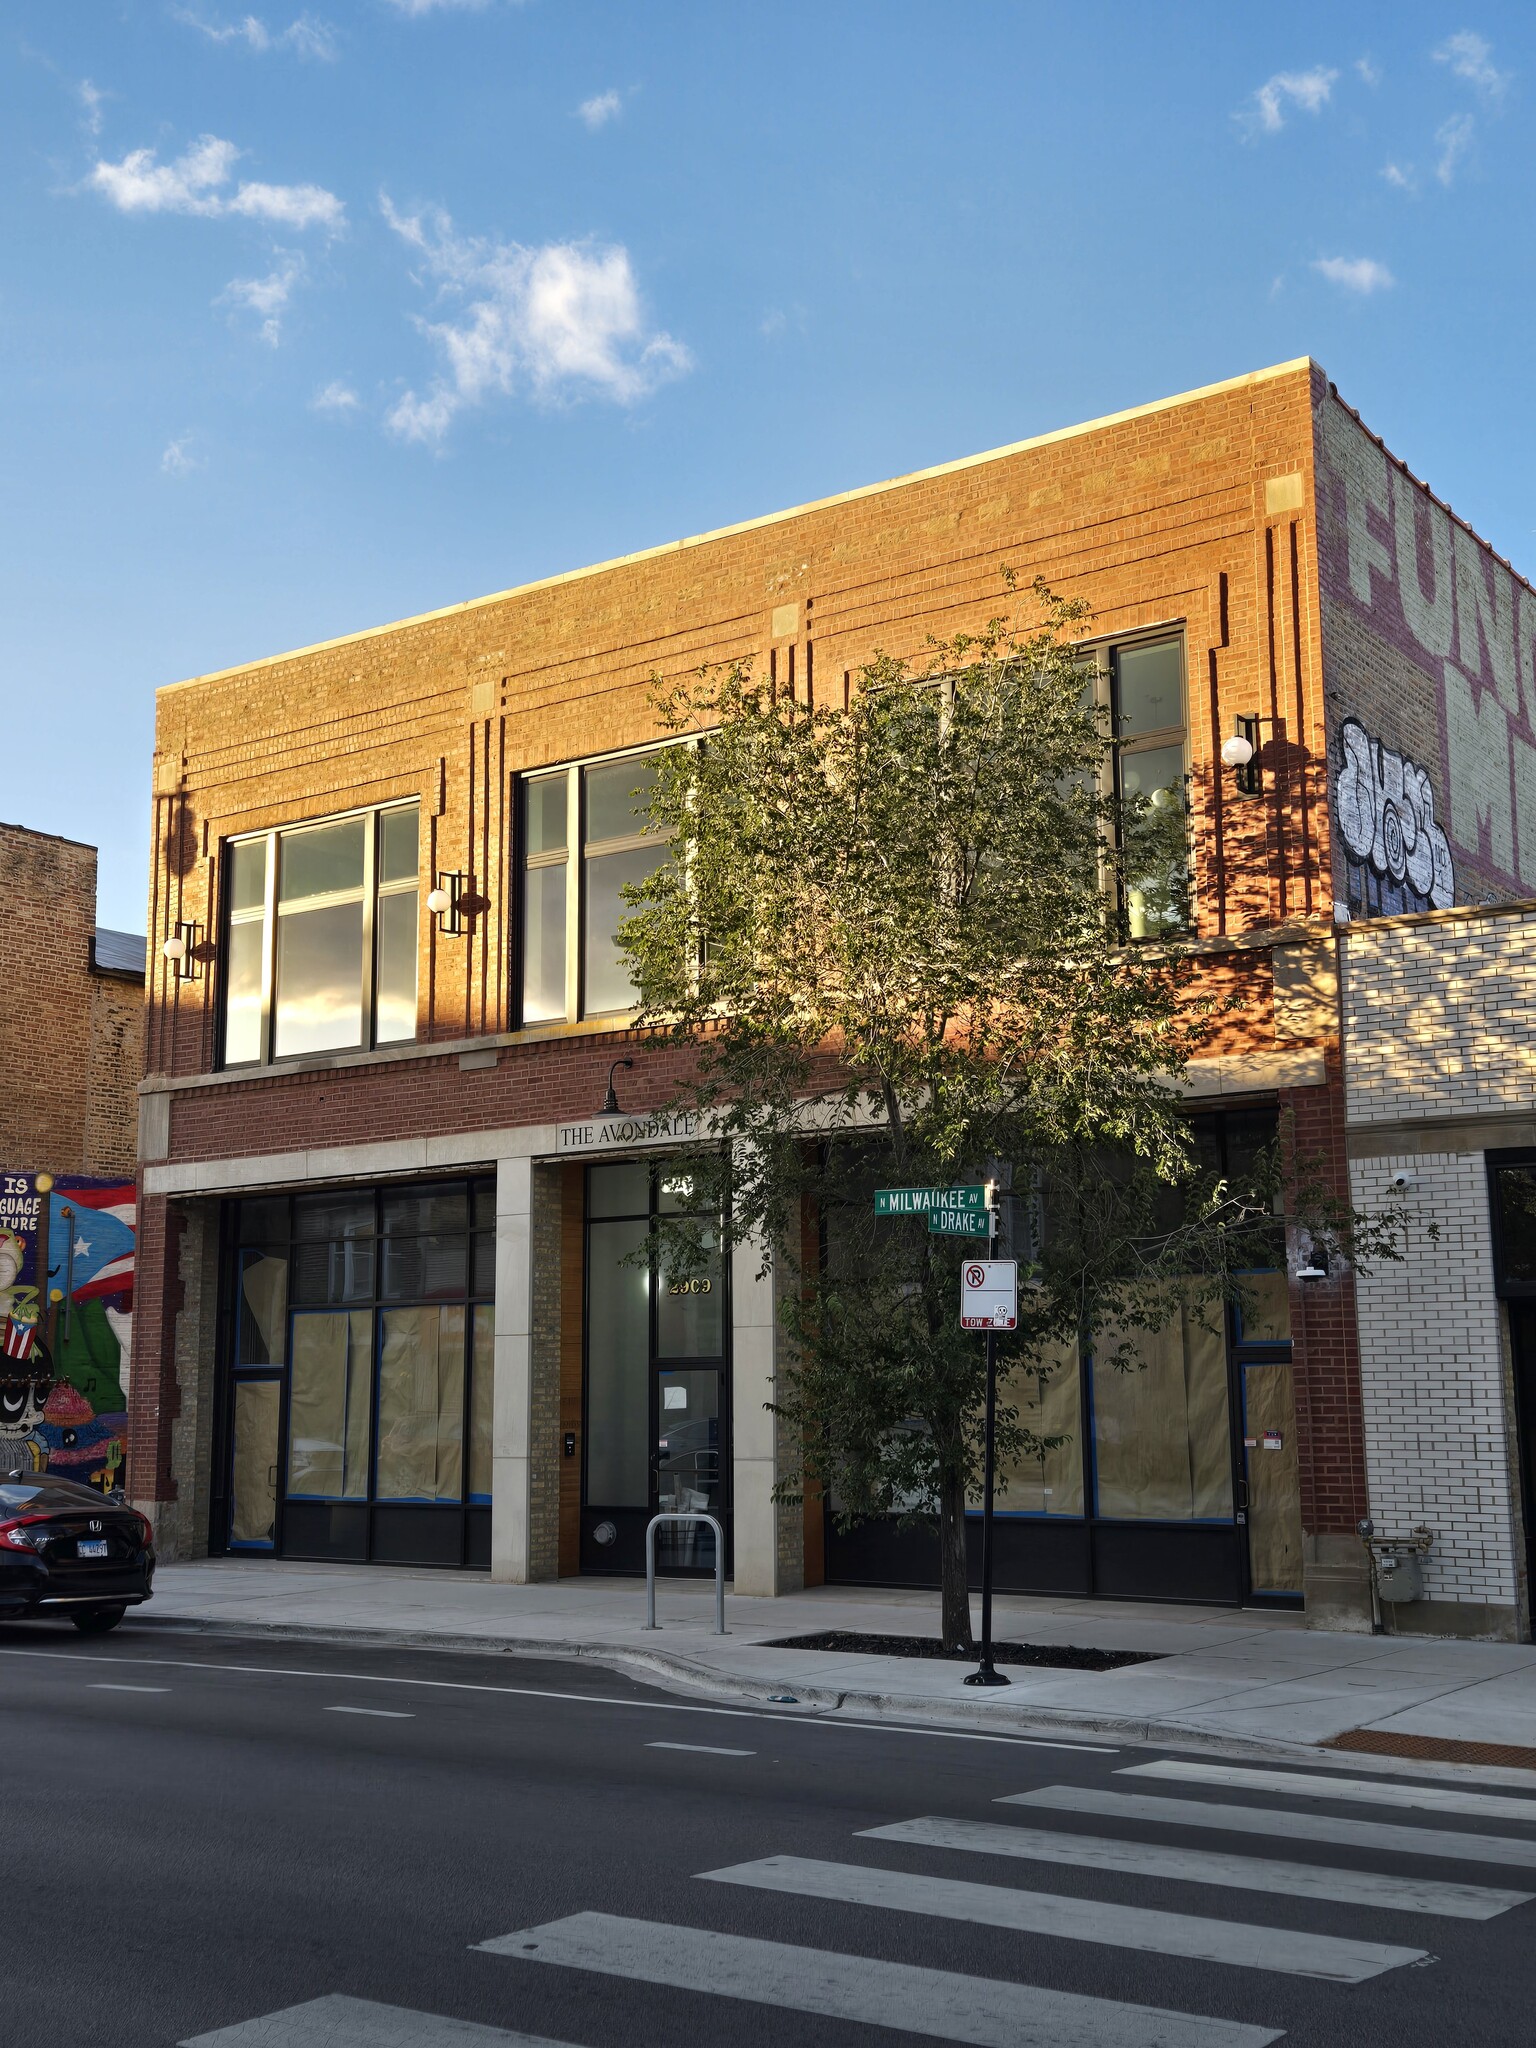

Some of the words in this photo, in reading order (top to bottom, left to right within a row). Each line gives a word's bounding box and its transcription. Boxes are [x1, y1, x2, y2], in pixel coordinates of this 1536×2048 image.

[561, 1126, 594, 1146] THE
[599, 1114, 695, 1142] AVONDALE
[4, 1177, 28, 1194] IS
[880, 1197, 886, 1208] N
[889, 1190, 966, 1211] MILWAUKEE
[968, 1193, 978, 1204] AV
[0, 1216, 37, 1231] TURE
[933, 1213, 938, 1225] N
[941, 1210, 976, 1232] DRAKE
[978, 1218, 985, 1229] AV
[965, 1318, 983, 1327] TOW
[987, 1318, 1011, 1327] ZE
